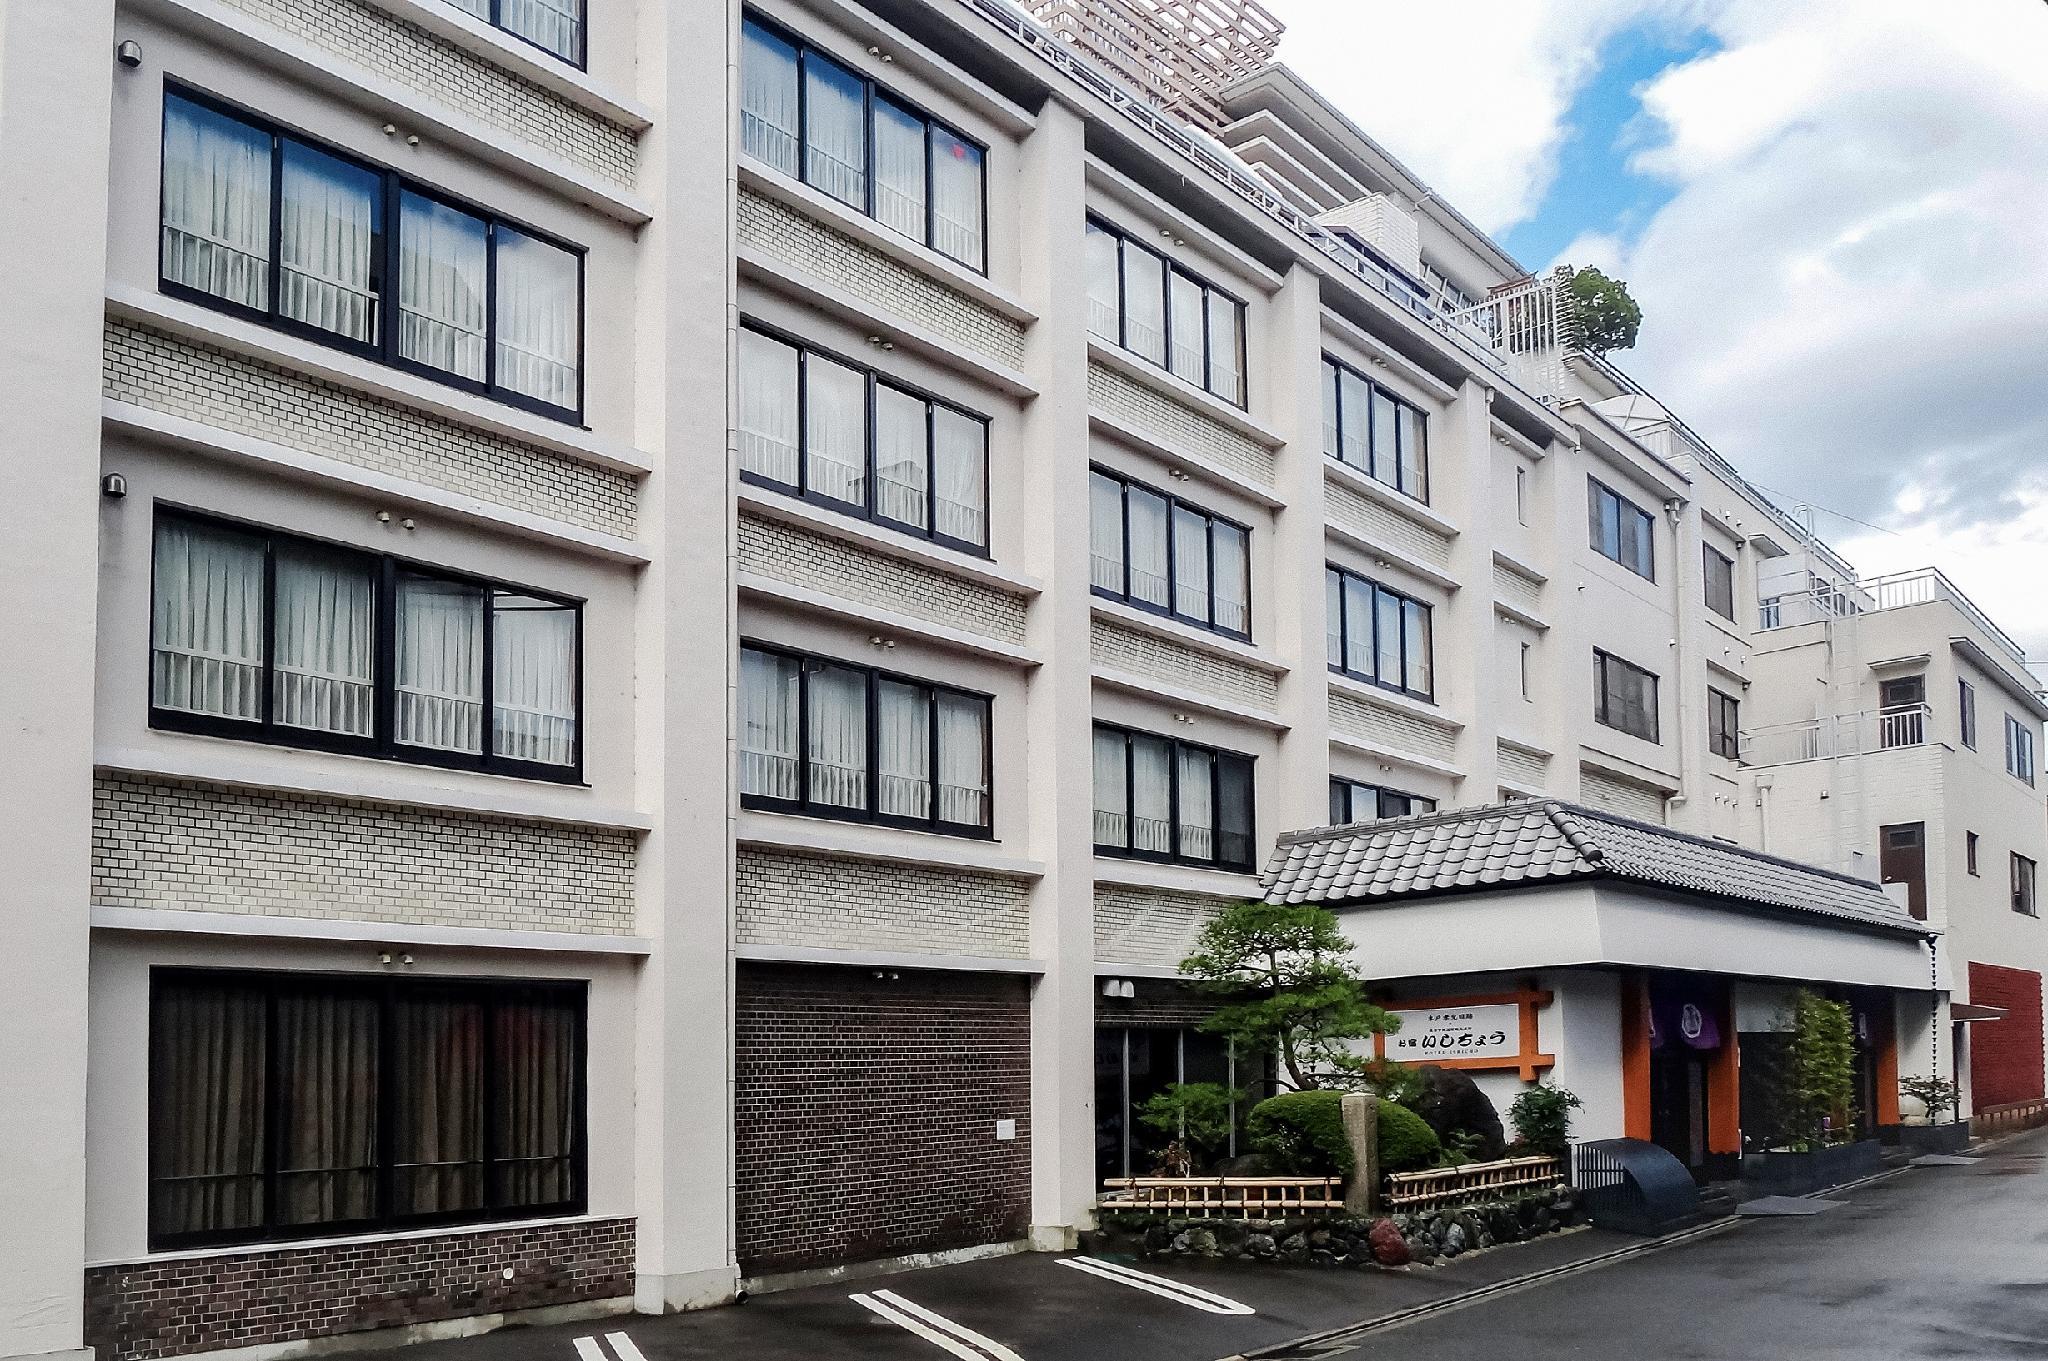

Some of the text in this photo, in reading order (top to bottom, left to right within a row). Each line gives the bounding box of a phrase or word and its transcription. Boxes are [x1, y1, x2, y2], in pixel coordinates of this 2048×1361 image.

[1422, 1031, 1506, 1048] いしちょう
